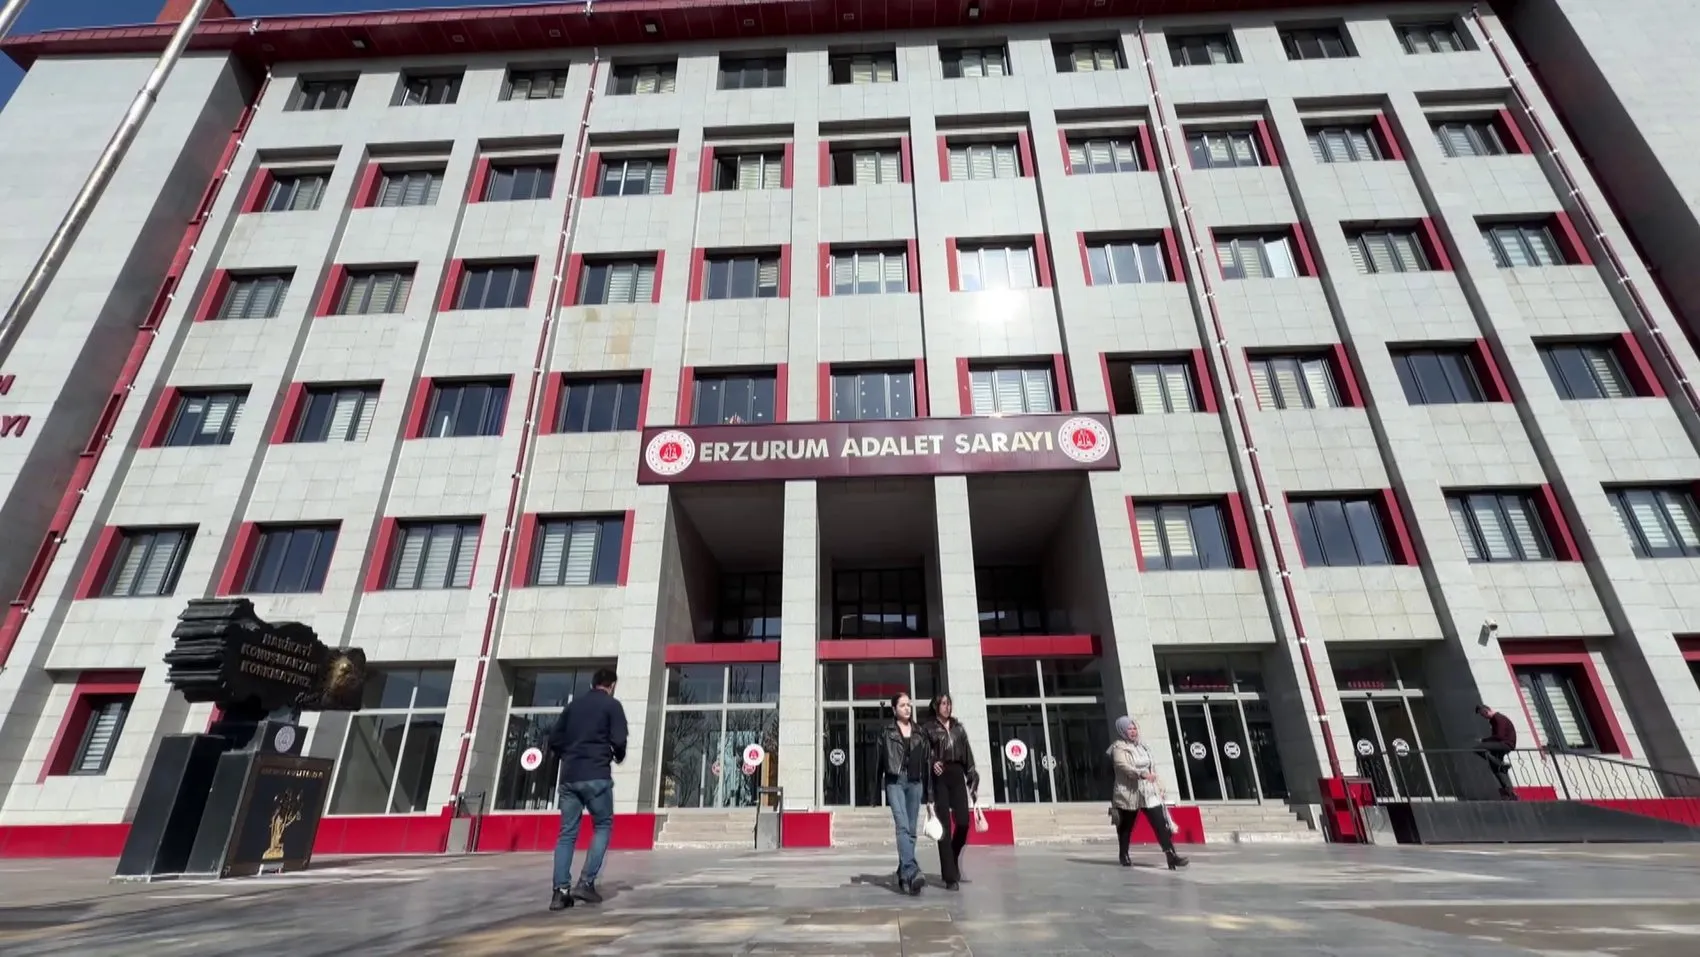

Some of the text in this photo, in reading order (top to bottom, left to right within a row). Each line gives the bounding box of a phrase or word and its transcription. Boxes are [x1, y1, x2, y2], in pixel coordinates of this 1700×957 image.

[699, 431, 1054, 463] ERZURUM ADALET SARAYI
